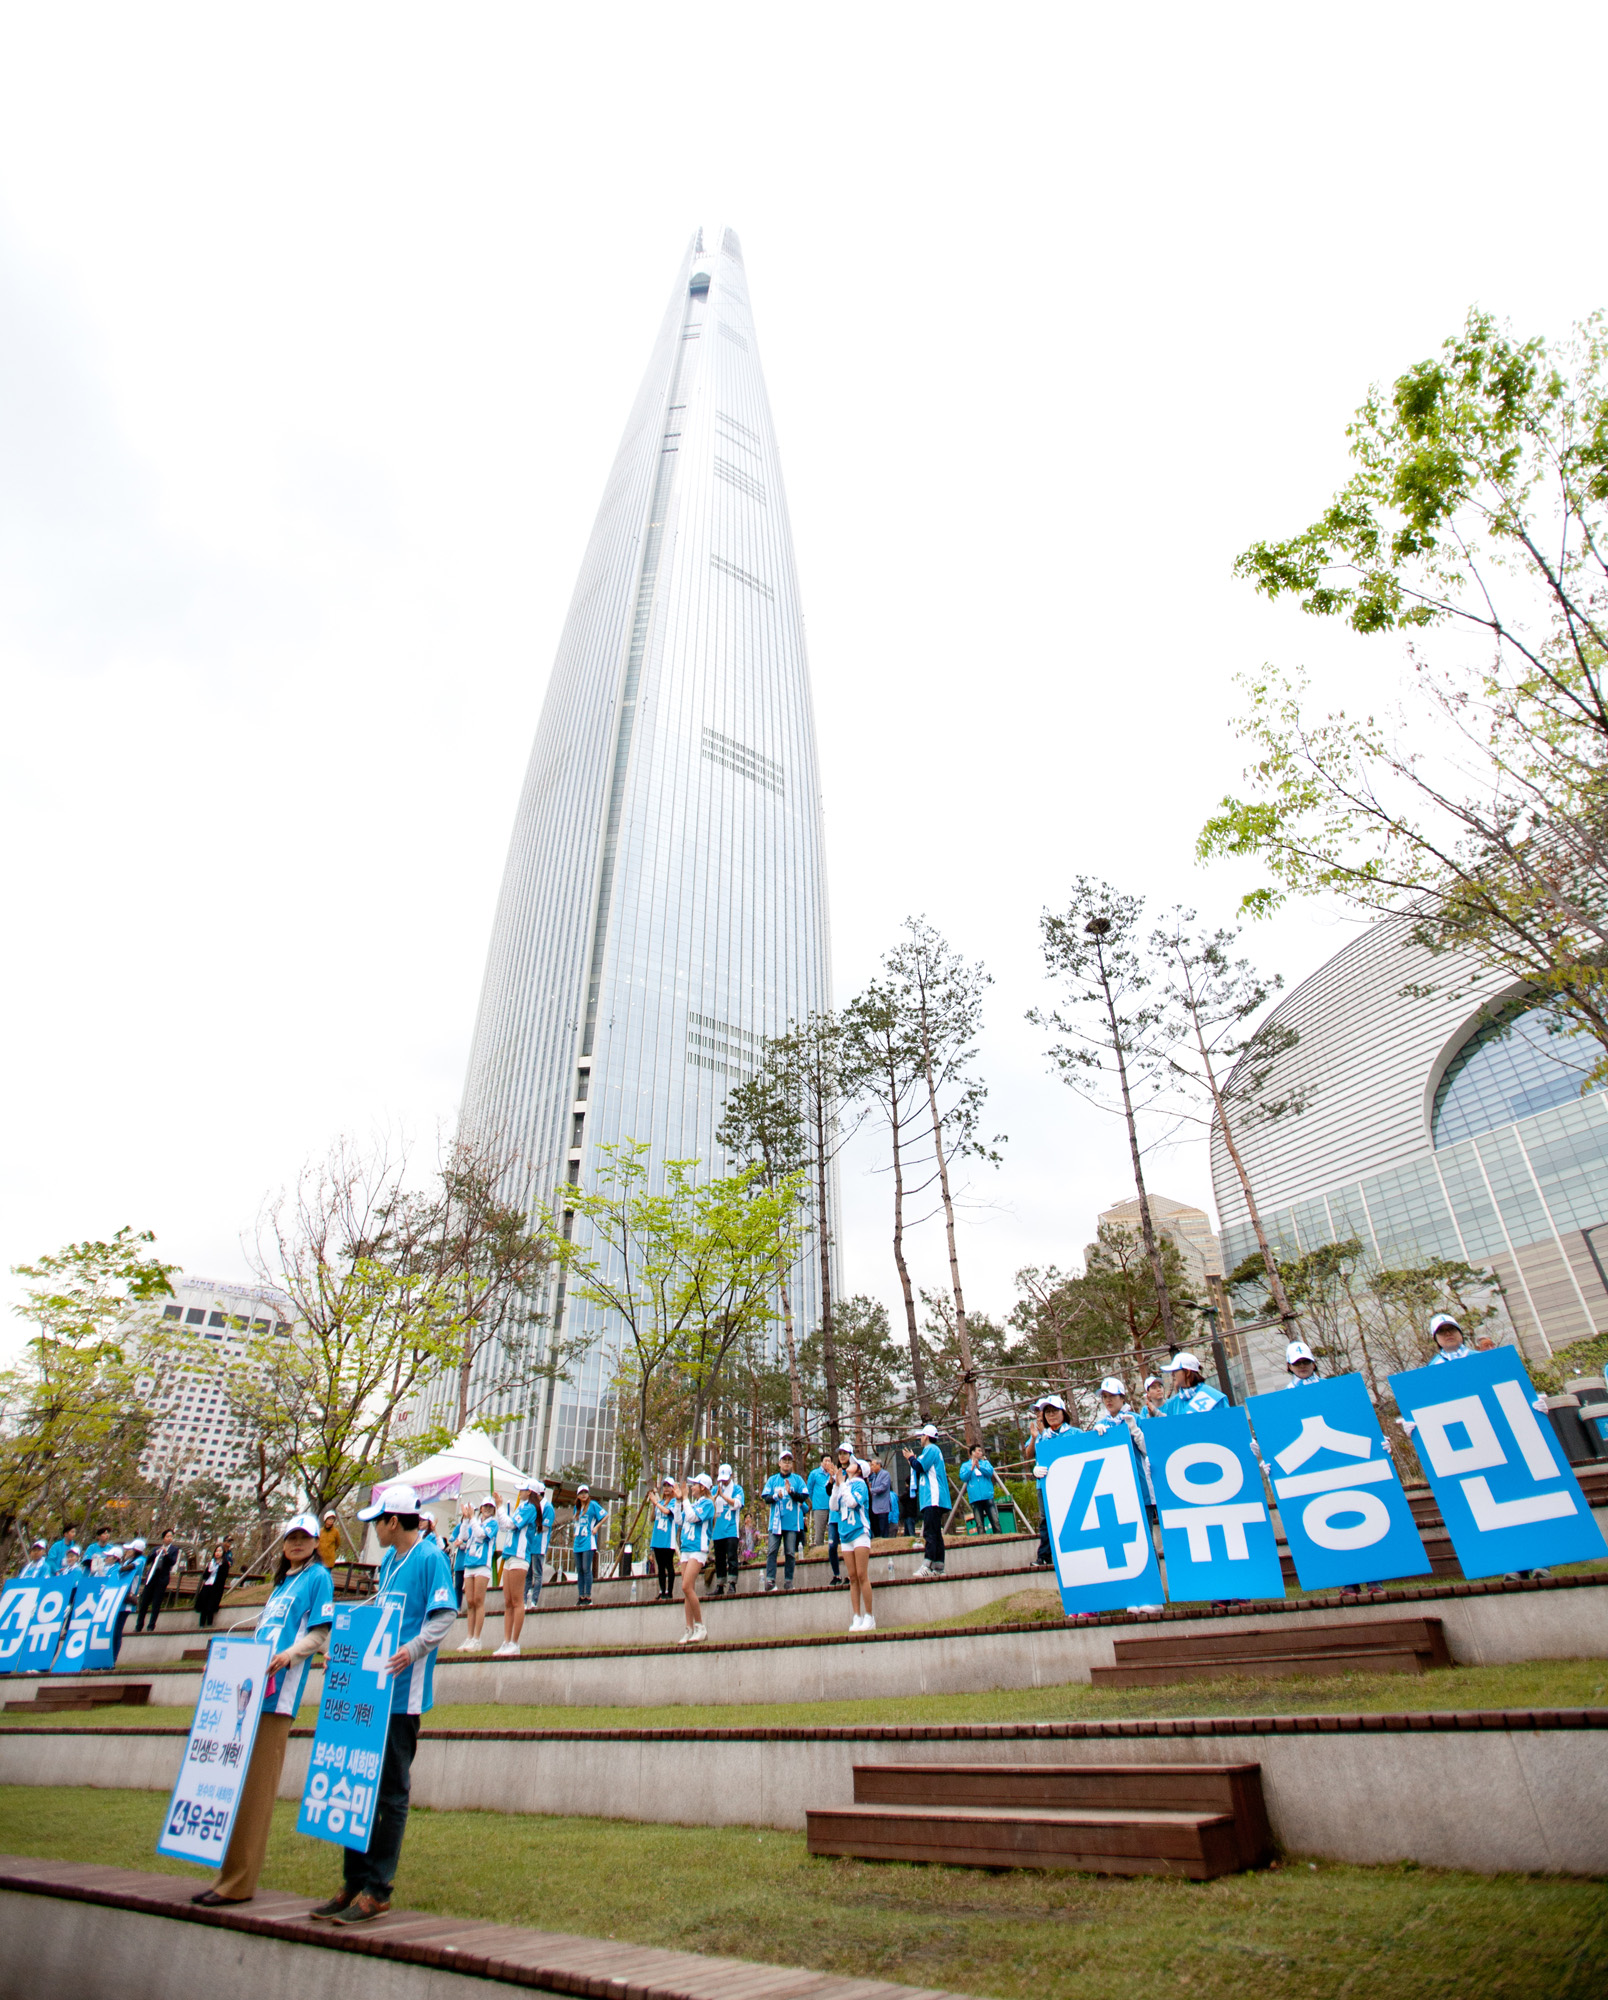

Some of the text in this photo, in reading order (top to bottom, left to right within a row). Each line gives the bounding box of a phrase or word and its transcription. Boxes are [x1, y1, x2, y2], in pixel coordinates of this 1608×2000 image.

[182, 1279, 216, 1292] LOTTE
[217, 1284, 251, 1297] HOTEL
[1057, 1379, 1579, 1569] 4 유승민
[332, 1642, 359, 1666] 안보는
[361, 1607, 394, 1691] 4
[206, 1678, 233, 1704] 안보는
[329, 1672, 350, 1692] 보수!
[198, 1709, 220, 1732] 보수!
[323, 1697, 374, 1728] 민생은 개혁!
[190, 1739, 243, 1767] 민생은 개혁!
[314, 1743, 380, 1781] 보수의 새희망
[304, 1772, 374, 1838] 유승민
[187, 1804, 230, 1842] 유승민
